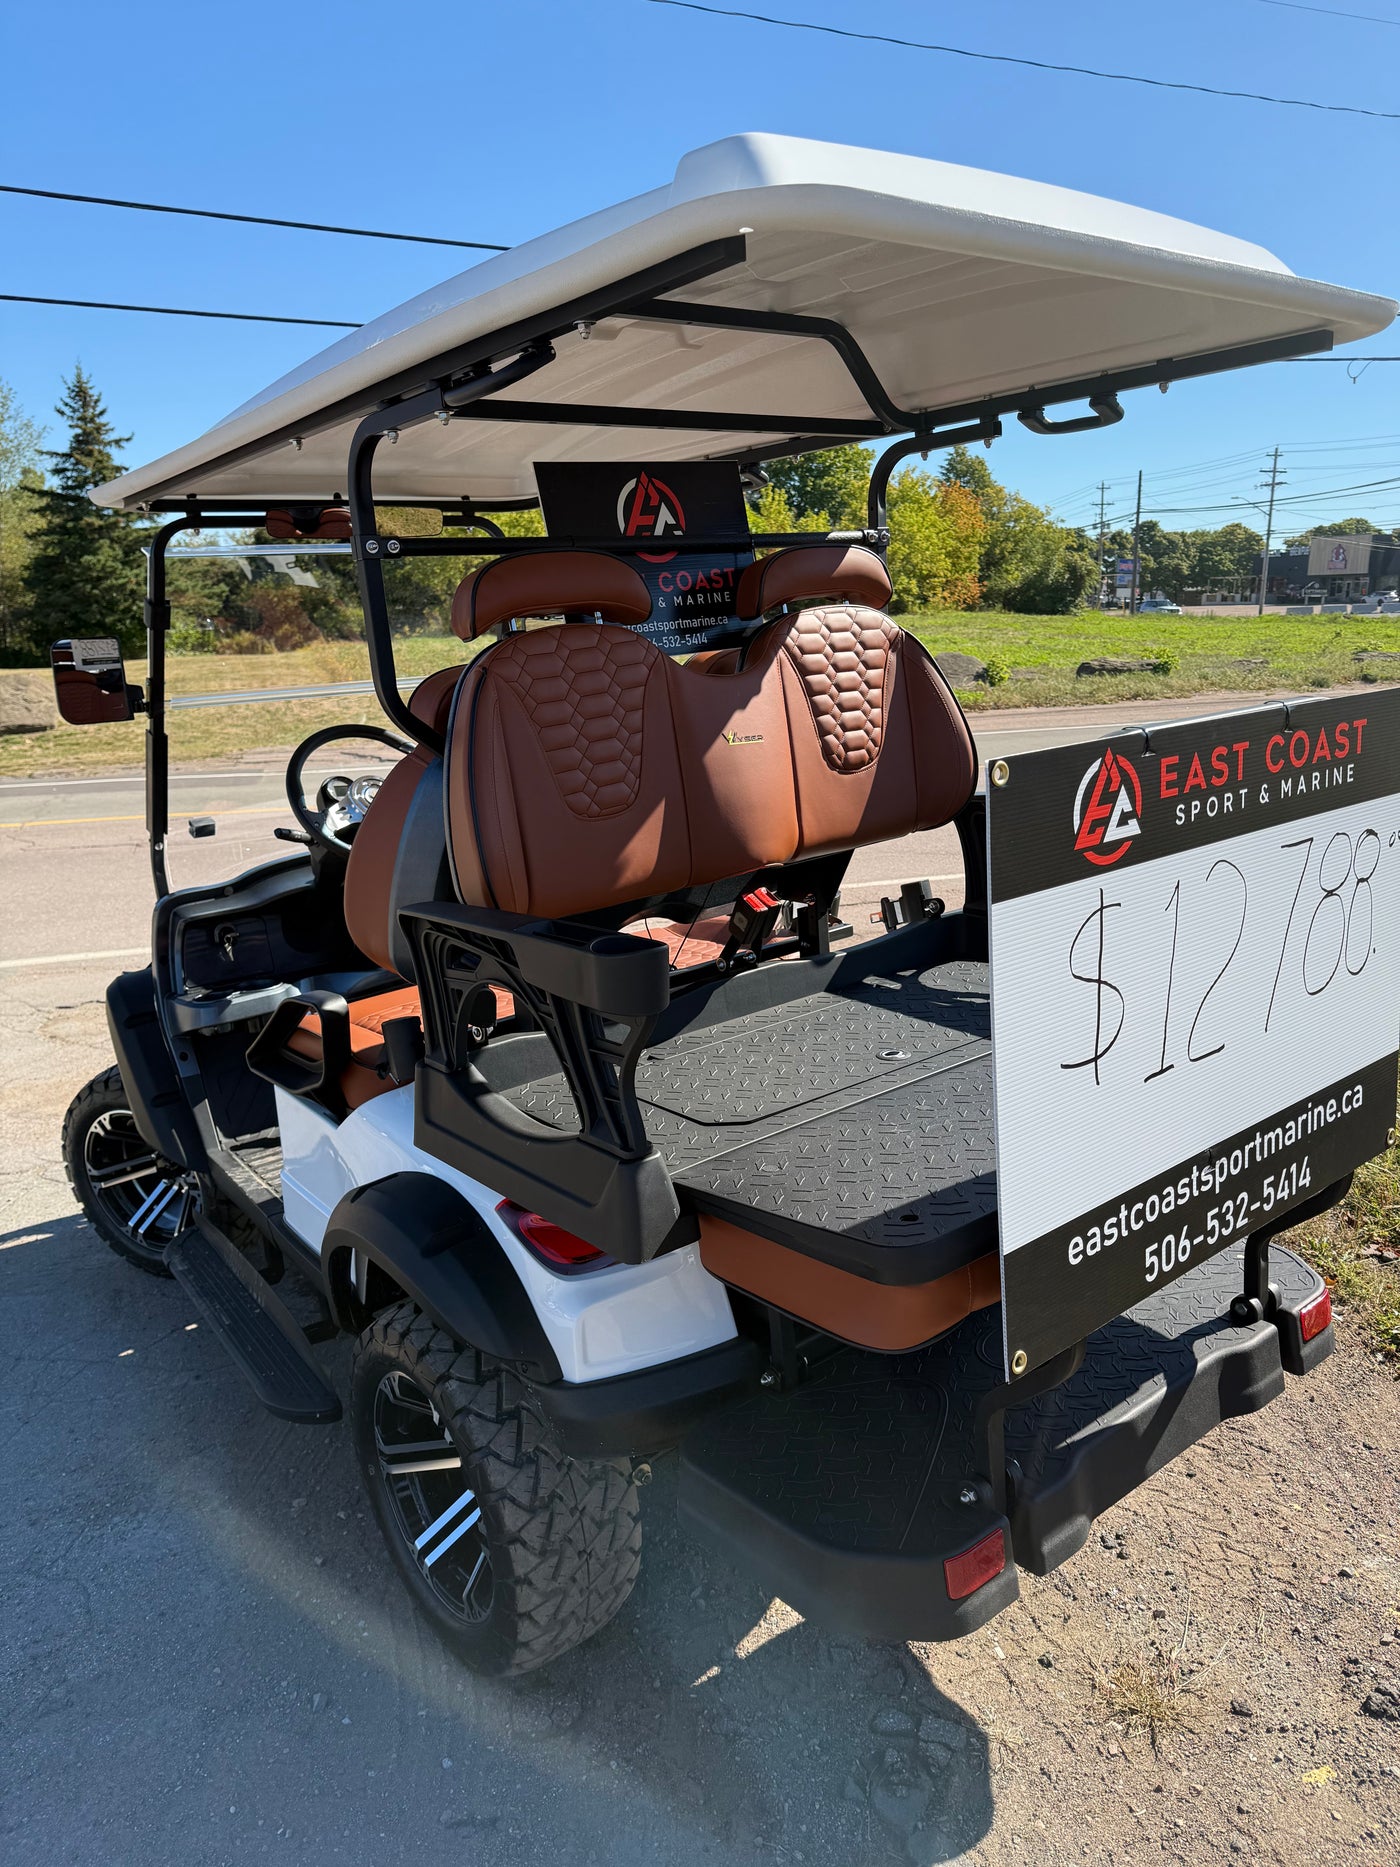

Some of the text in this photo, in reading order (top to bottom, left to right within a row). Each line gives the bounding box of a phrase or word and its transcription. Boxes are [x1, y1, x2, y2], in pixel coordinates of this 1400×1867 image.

[658, 568, 735, 593] COAST
[658, 591, 731, 608] & MARINE
[1160, 718, 1368, 799] EAST COAST
[1175, 763, 1355, 826] SPORT & MARINE
[1068, 1084, 1364, 1266] eastcoastsportmarine.ca
[1144, 1155, 1312, 1283] 506-532-5414
